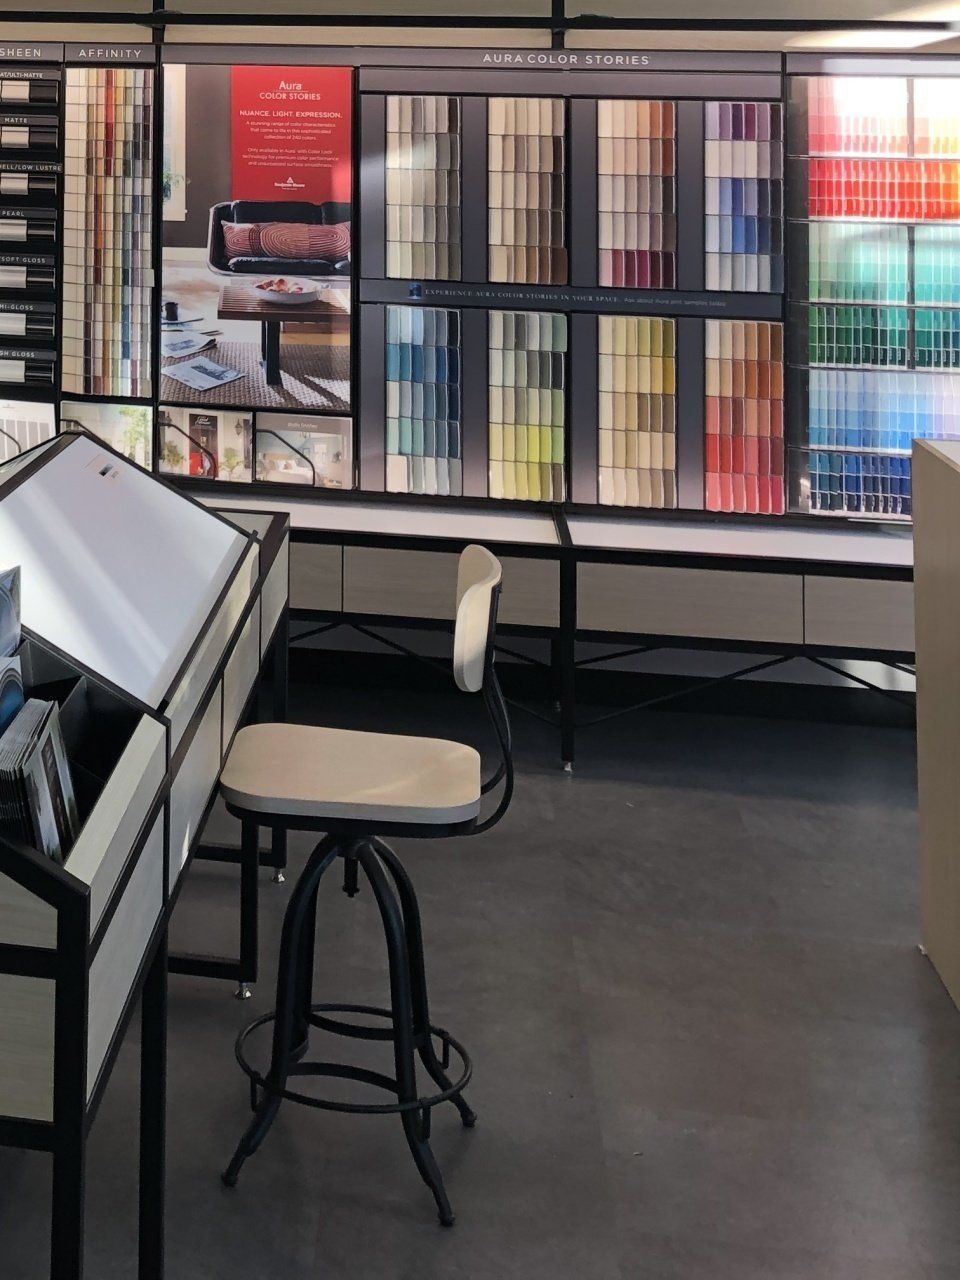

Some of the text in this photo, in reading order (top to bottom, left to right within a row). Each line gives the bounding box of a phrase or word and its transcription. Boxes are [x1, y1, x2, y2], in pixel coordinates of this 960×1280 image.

[78, 49, 142, 58] AFFINITY
[482, 53, 650, 65] AURA COLOR STORIES
[279, 80, 302, 90] Aura
[259, 92, 321, 101] COLOR STORIES
[296, 111, 343, 119] EXPRESSION.
